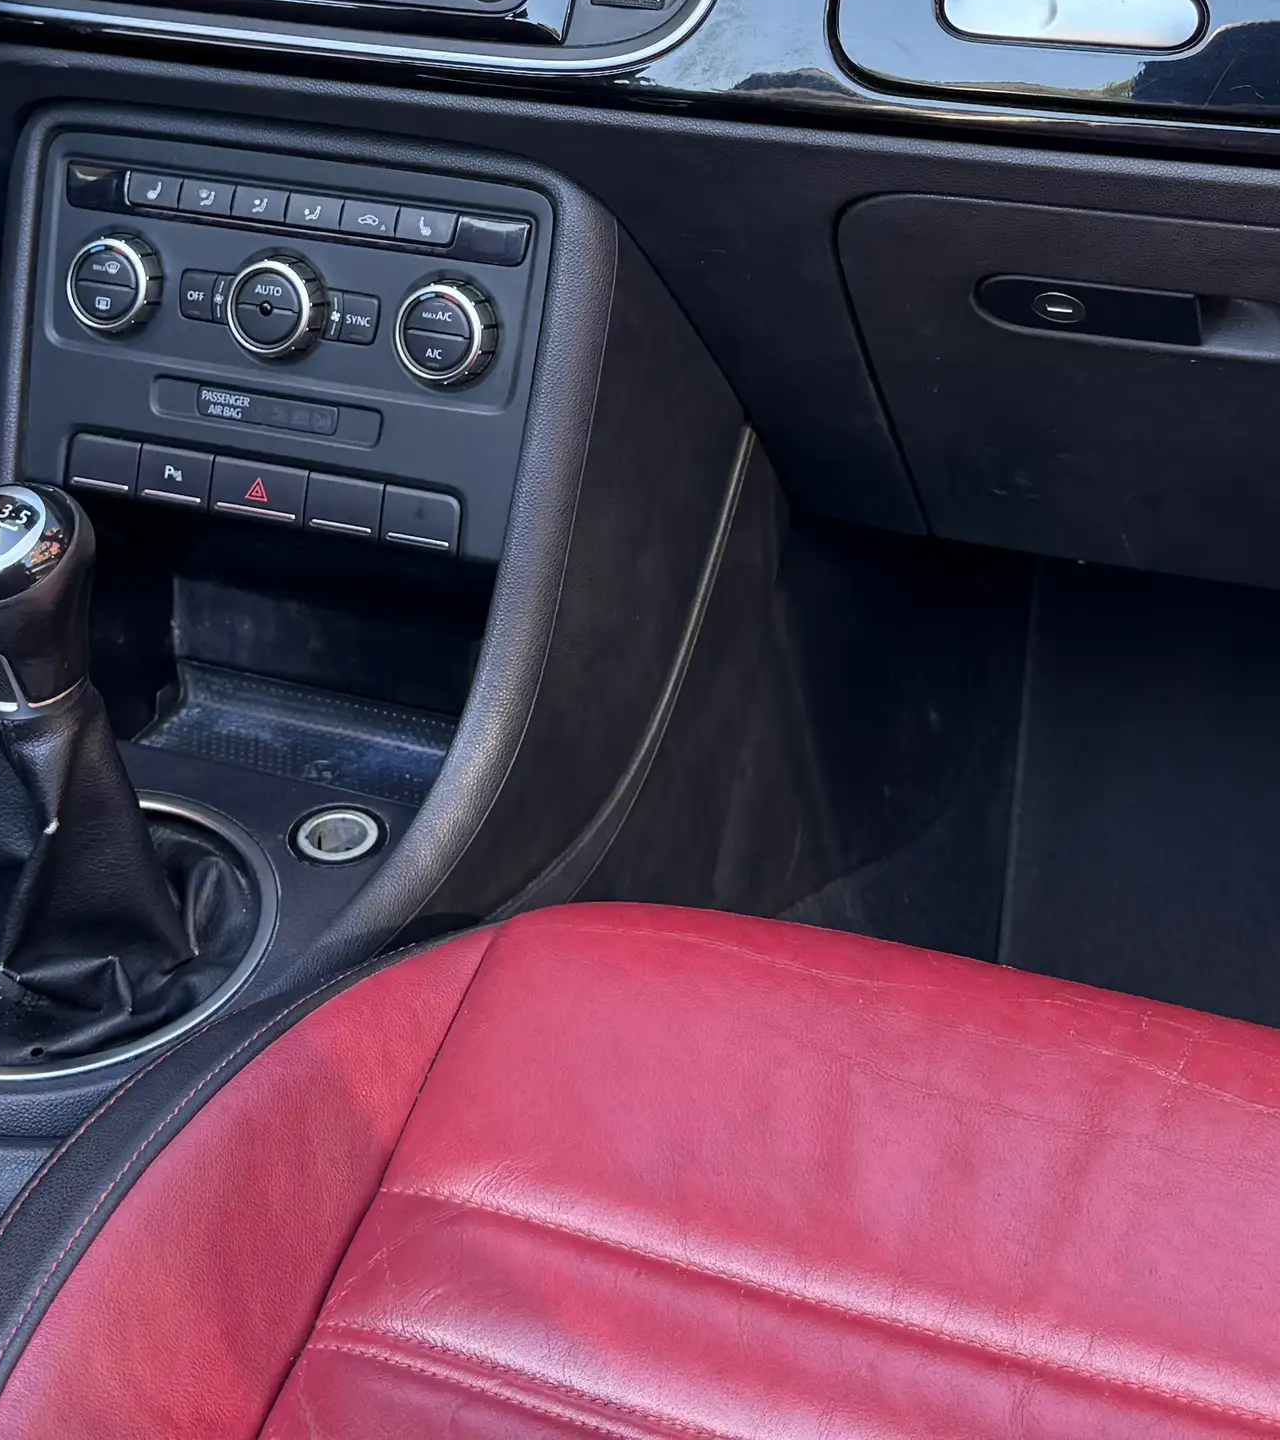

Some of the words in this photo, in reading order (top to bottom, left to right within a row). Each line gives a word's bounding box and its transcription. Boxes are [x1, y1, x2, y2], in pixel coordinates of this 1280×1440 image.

[187, 290, 205, 301] OFF
[255, 284, 282, 297] AUTO
[345, 314, 371, 327] SYNC
[425, 348, 442, 359] A/C
[201, 390, 250, 408] PASSENGER
